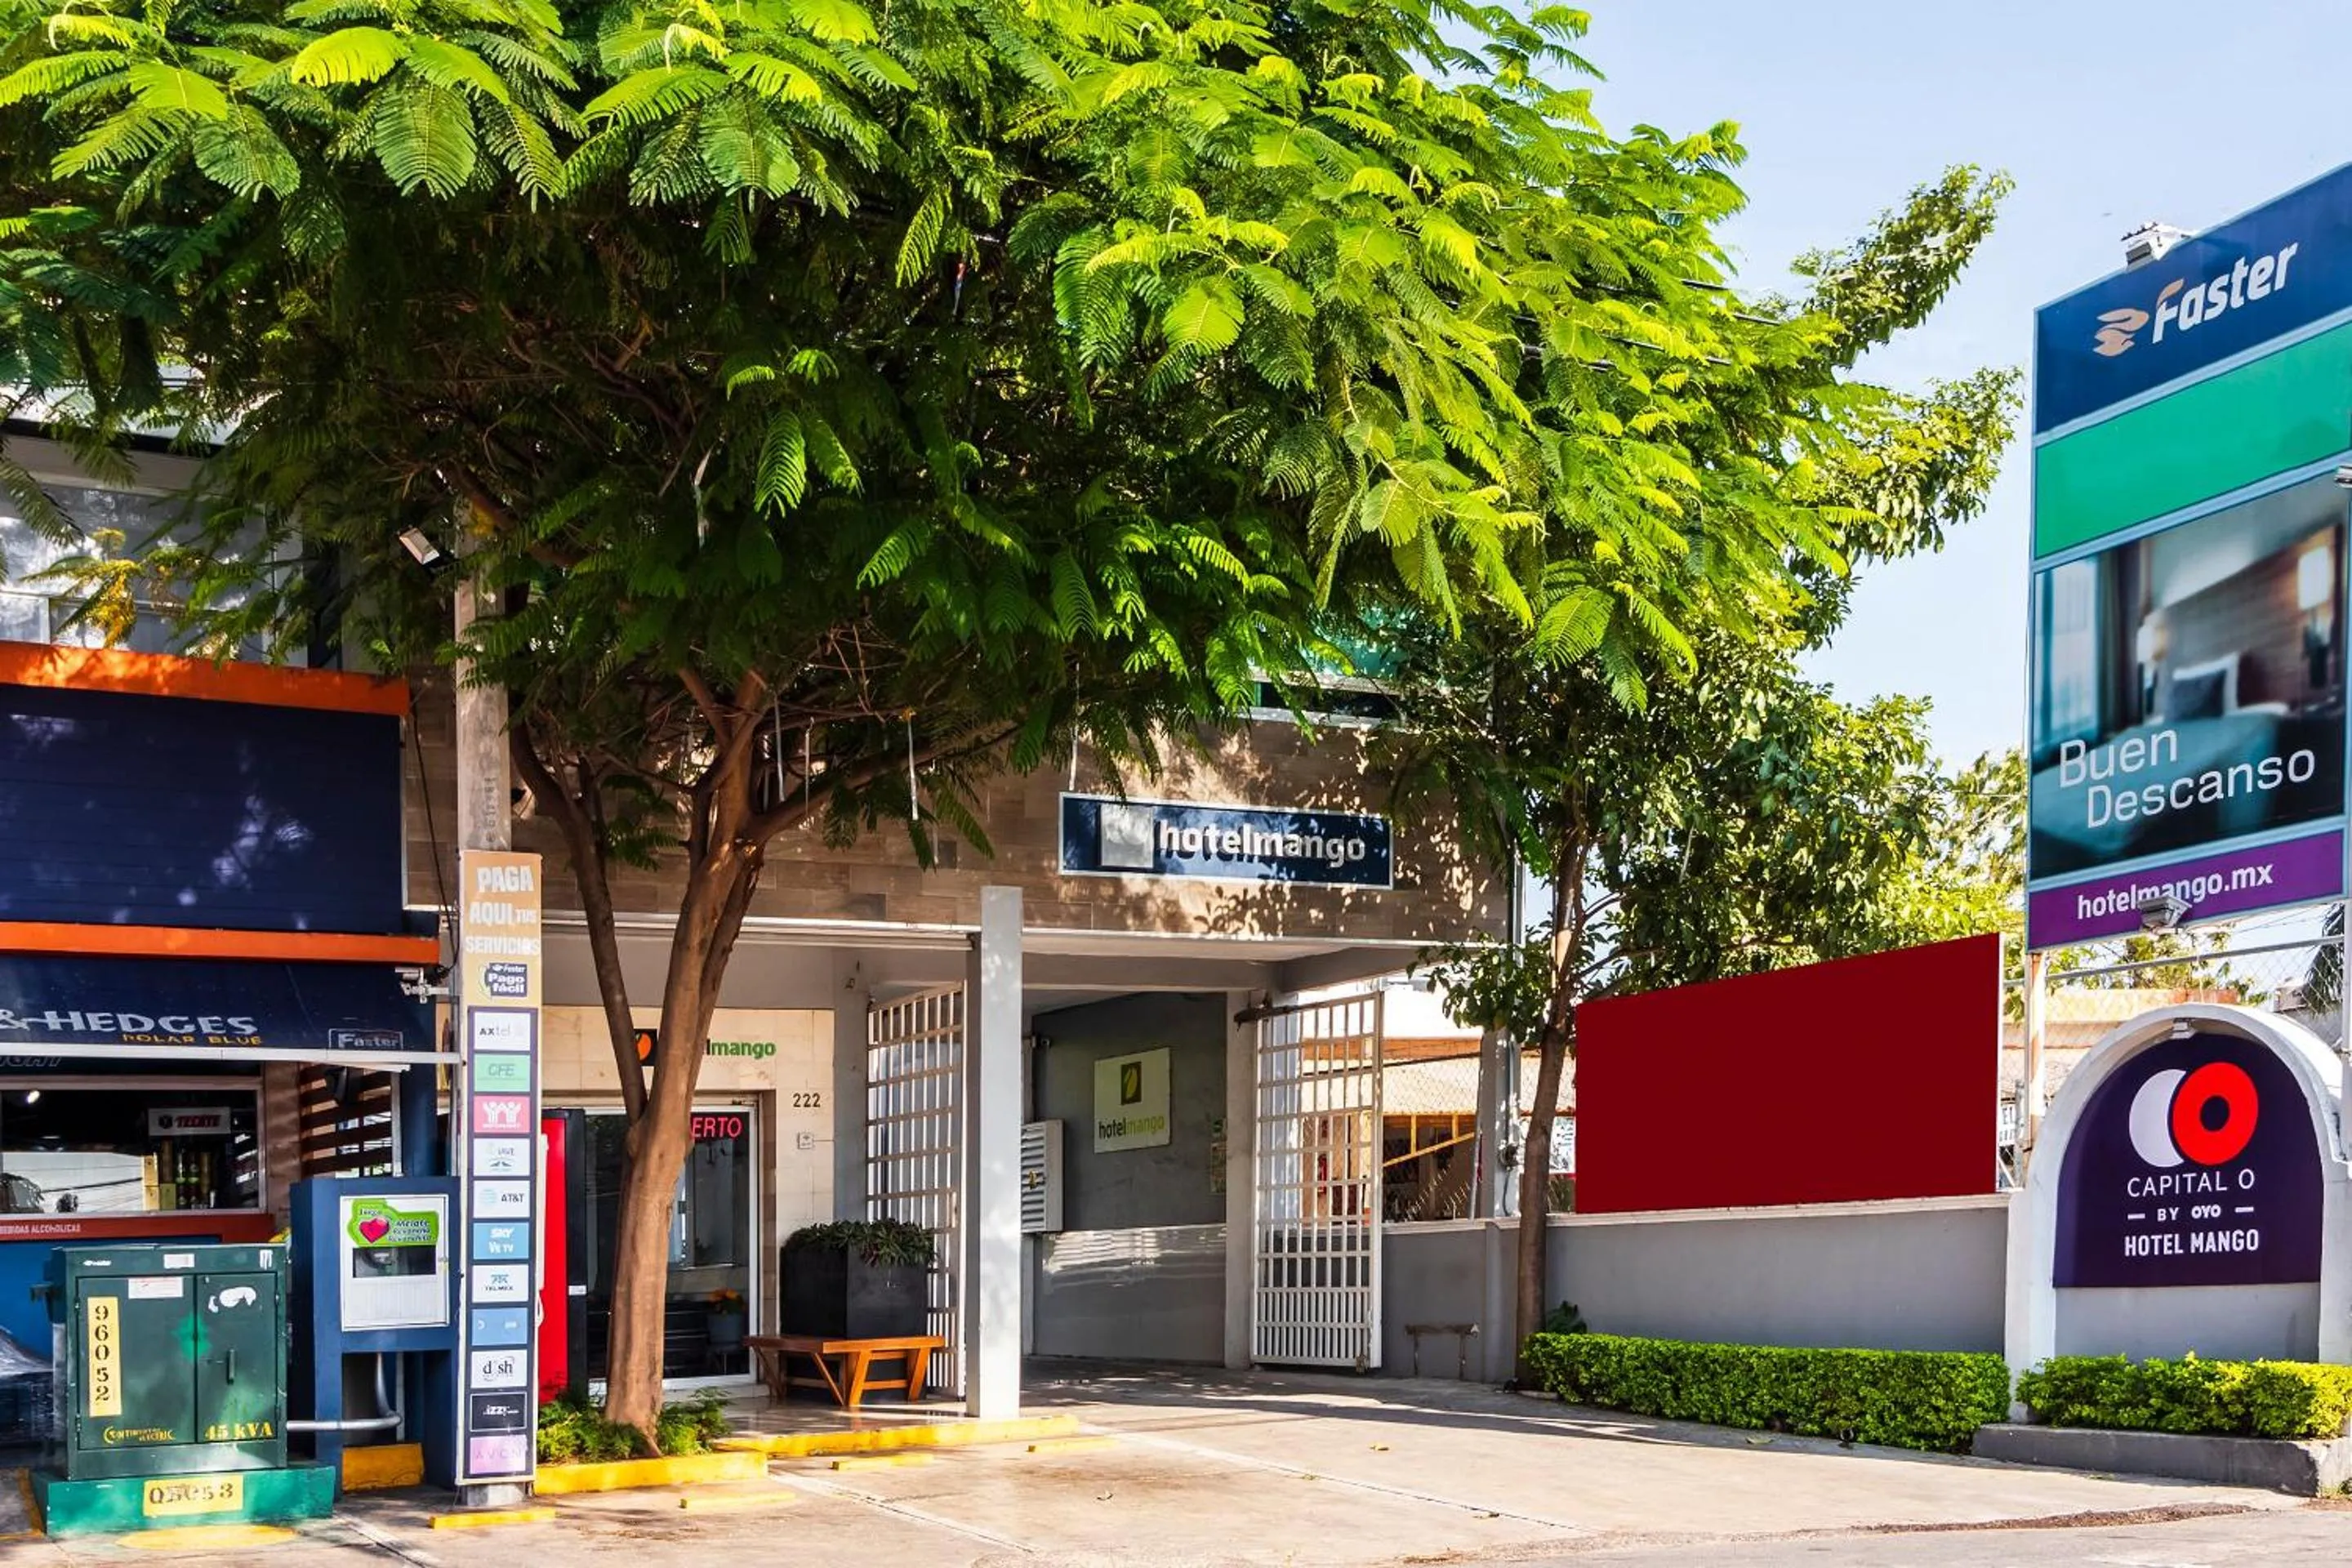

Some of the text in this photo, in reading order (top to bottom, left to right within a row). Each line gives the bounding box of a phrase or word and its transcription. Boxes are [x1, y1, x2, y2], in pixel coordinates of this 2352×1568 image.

[2152, 243, 2298, 344] Faster
[2060, 728, 2179, 788] Buen
[2087, 748, 2316, 829] Descanso
[1160, 819, 1366, 867] hotelmango
[477, 865, 535, 893] PAGA
[2077, 863, 2274, 920] hotelmango.mx
[466, 936, 540, 956] SERVICIOS
[488, 973, 525, 985] Pago
[44, 1011, 258, 1035] HEDGES
[208, 1036, 262, 1046] BLUE
[793, 1093, 821, 1107] 222
[1098, 1116, 1165, 1140] hotelmango
[2127, 1169, 2256, 1198] CAPITAL O
[501, 1193, 524, 1203] AT&T
[2157, 1204, 2221, 1222] BY OYO
[2124, 1228, 2259, 1257] HOTEL MANGO
[94, 1305, 109, 1402] 96052
